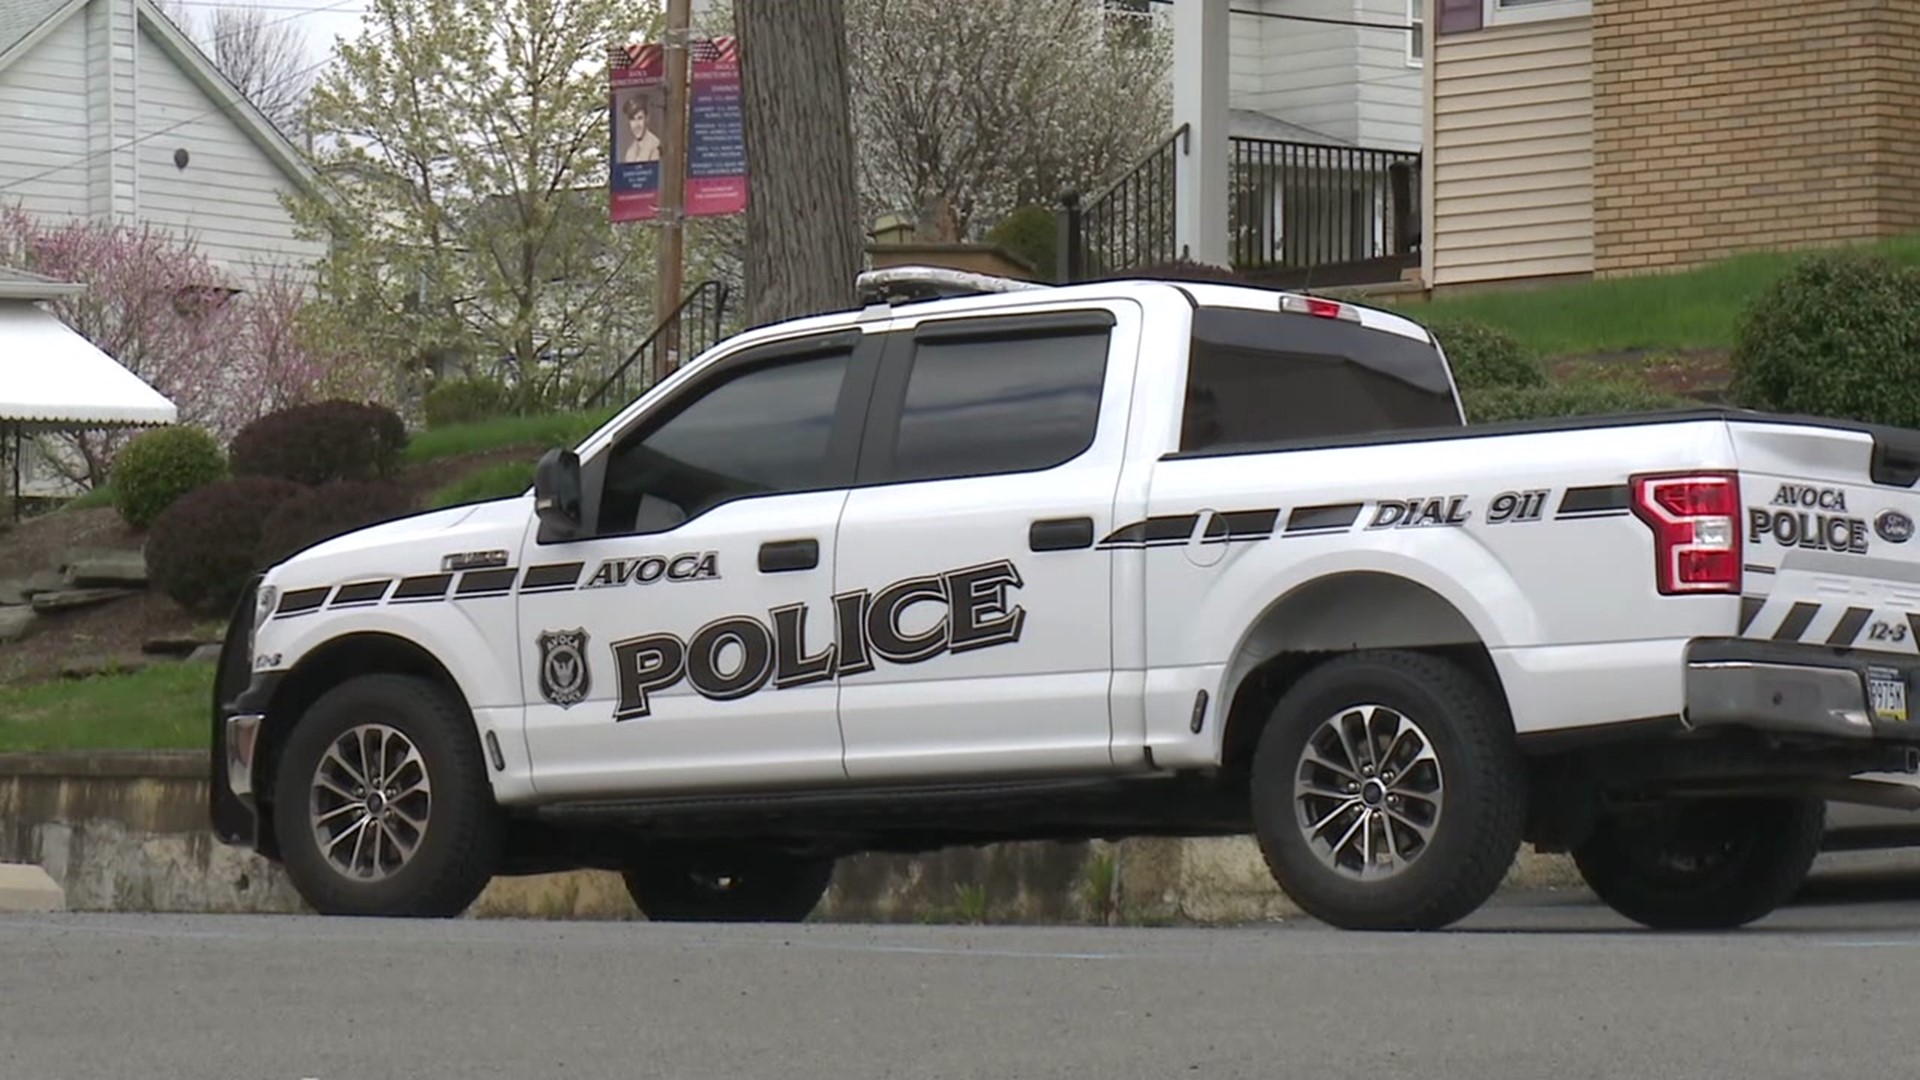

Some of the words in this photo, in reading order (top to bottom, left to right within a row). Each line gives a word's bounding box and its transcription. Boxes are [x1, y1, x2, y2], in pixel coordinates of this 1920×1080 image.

[1364, 495, 1472, 530] DIAL
[1487, 489, 1551, 524] 911
[1770, 483, 1848, 512] AVOCA
[1748, 508, 1869, 555] POLICE
[580, 551, 722, 590] AVOCA
[610, 560, 1027, 722] POLICE
